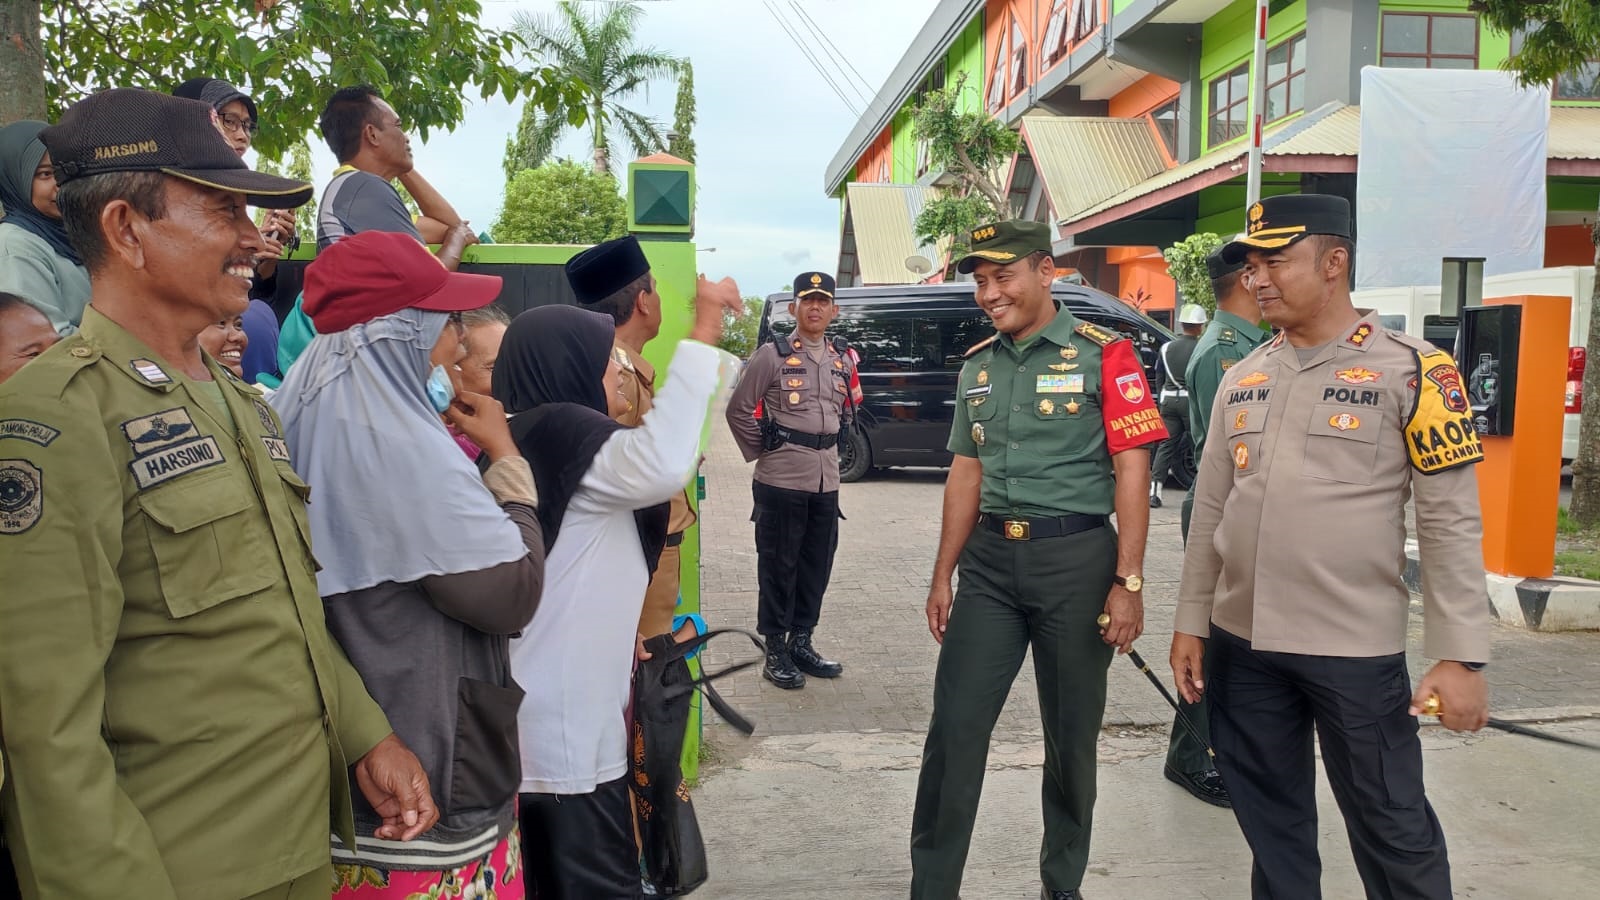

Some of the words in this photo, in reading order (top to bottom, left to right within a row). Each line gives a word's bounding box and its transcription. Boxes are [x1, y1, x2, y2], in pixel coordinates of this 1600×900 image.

[95, 139, 158, 160] HARSONO
[1228, 390, 1254, 405] JAKA
[1257, 388, 1270, 401] W
[1323, 387, 1379, 406] POLRI
[145, 442, 214, 479] HARSONO
